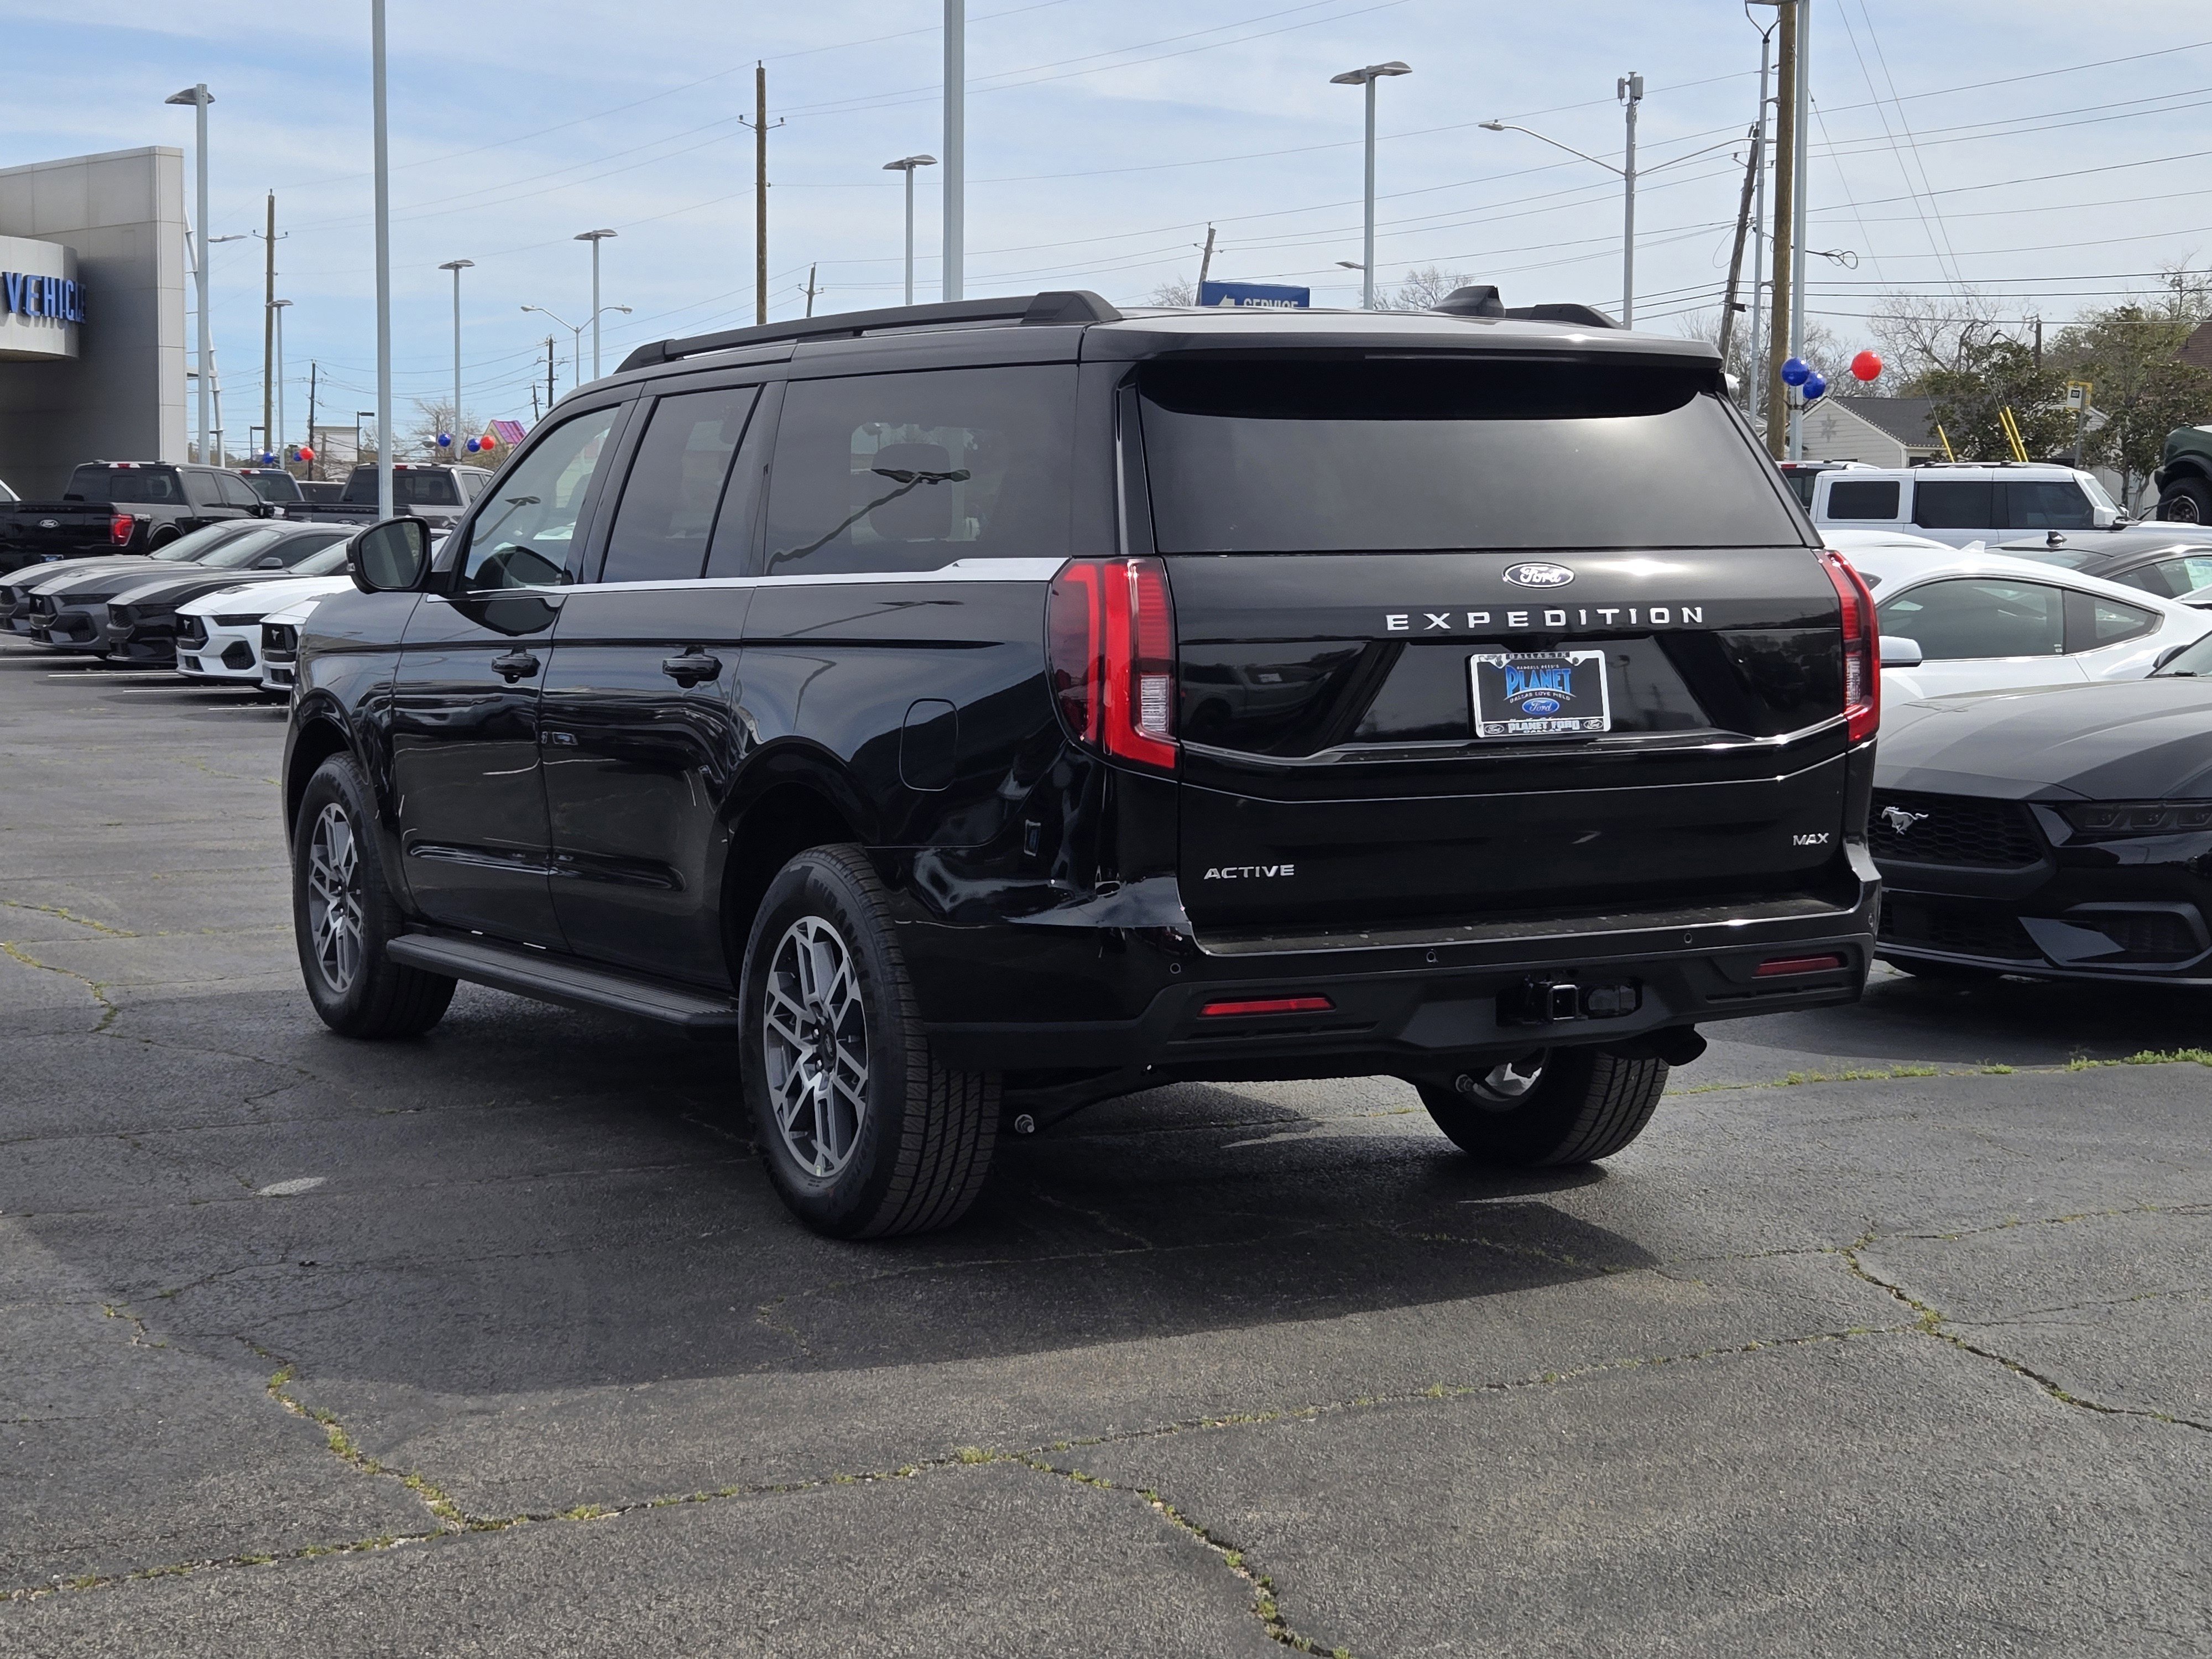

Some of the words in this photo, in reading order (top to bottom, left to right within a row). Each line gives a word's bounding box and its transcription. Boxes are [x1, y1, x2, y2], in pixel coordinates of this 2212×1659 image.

[1520, 566, 1562, 583] Ford
[1385, 607, 1703, 631] EXPEDITION
[1505, 665, 1571, 697] PLANET
[1507, 721, 1548, 733] PLANET
[1793, 832, 1829, 846] MAX
[1203, 864, 1295, 880] ACTIVE
